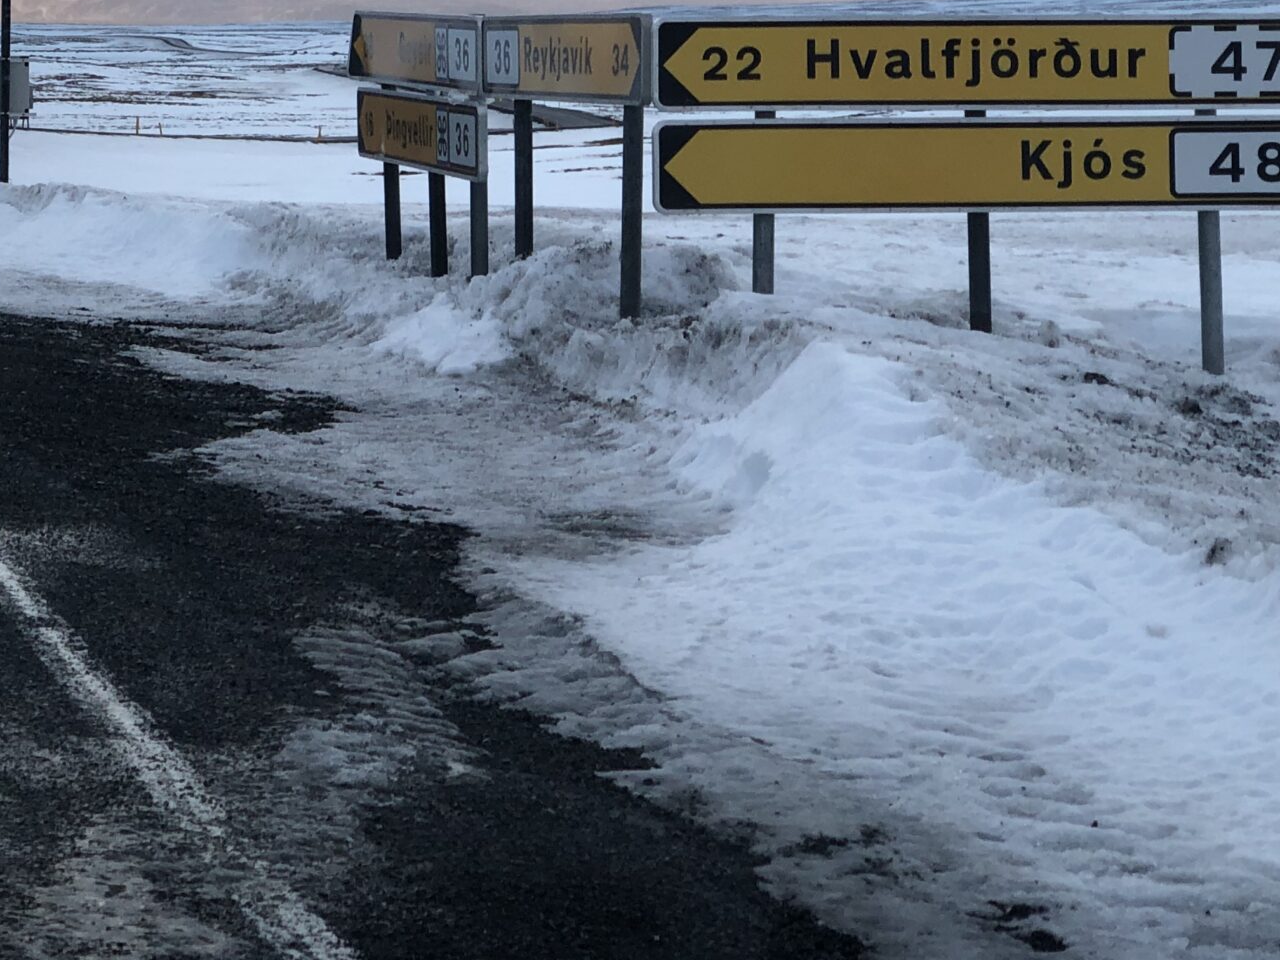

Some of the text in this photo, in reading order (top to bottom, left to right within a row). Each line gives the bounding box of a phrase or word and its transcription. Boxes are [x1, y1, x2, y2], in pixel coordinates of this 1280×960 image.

[455, 37, 469, 73] 36
[494, 39, 511, 75] 36
[612, 43, 629, 77] 34
[702, 37, 1280, 87] 22 Hvalfjörður 47
[455, 122, 469, 157] 36
[1021, 138, 1280, 189] Kjós 48
